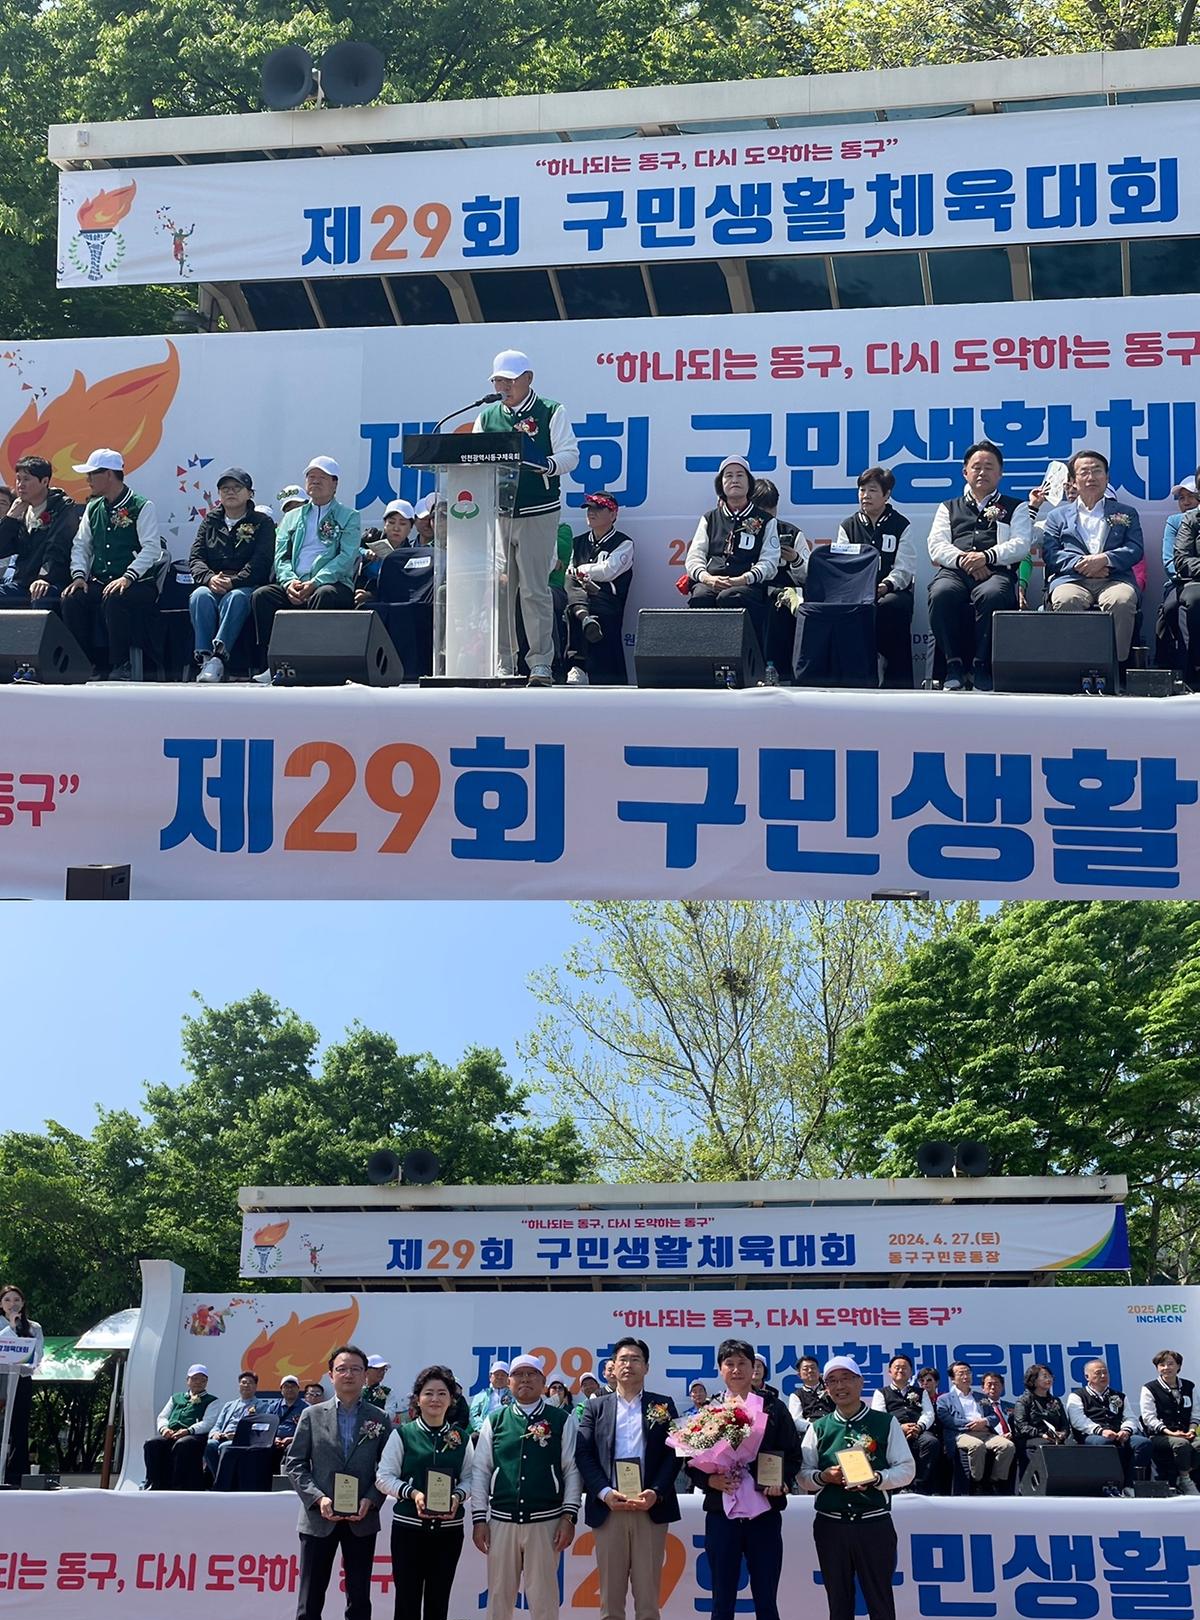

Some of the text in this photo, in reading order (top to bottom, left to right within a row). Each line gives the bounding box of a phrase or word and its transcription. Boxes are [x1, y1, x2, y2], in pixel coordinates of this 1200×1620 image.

[638, 151, 688, 172] 동구,
[694, 147, 738, 169] 다시
[743, 143, 834, 165] 도약하는
[300, 156, 1178, 268] 제29회 구민생활체육대회
[769, 343, 854, 381] 동구,
[866, 339, 940, 376] 다시
[952, 334, 1111, 372] 도약하는
[354, 412, 650, 509] 제회
[738, 532, 756, 550] D
[881, 533, 897, 553] D
[159, 736, 1199, 889] 제29회 구민생활
[607, 1217, 631, 1231] 다시
[634, 1216, 680, 1230] 도약하는
[386, 1235, 514, 1272] 제29회
[536, 1231, 856, 1271] 구민생활체육대회
[888, 1232, 929, 1247] 2024.
[933, 1232, 947, 1246] 4.
[888, 1250, 1001, 1265] 동구구민운동장
[712, 1308, 761, 1329] 동구,
[766, 1307, 809, 1328] 다시
[815, 1306, 902, 1328] 도약하는
[1136, 1315, 1183, 1323] INCHEON
[56, 1551, 126, 1594] 동구,
[135, 1553, 197, 1592] 다시
